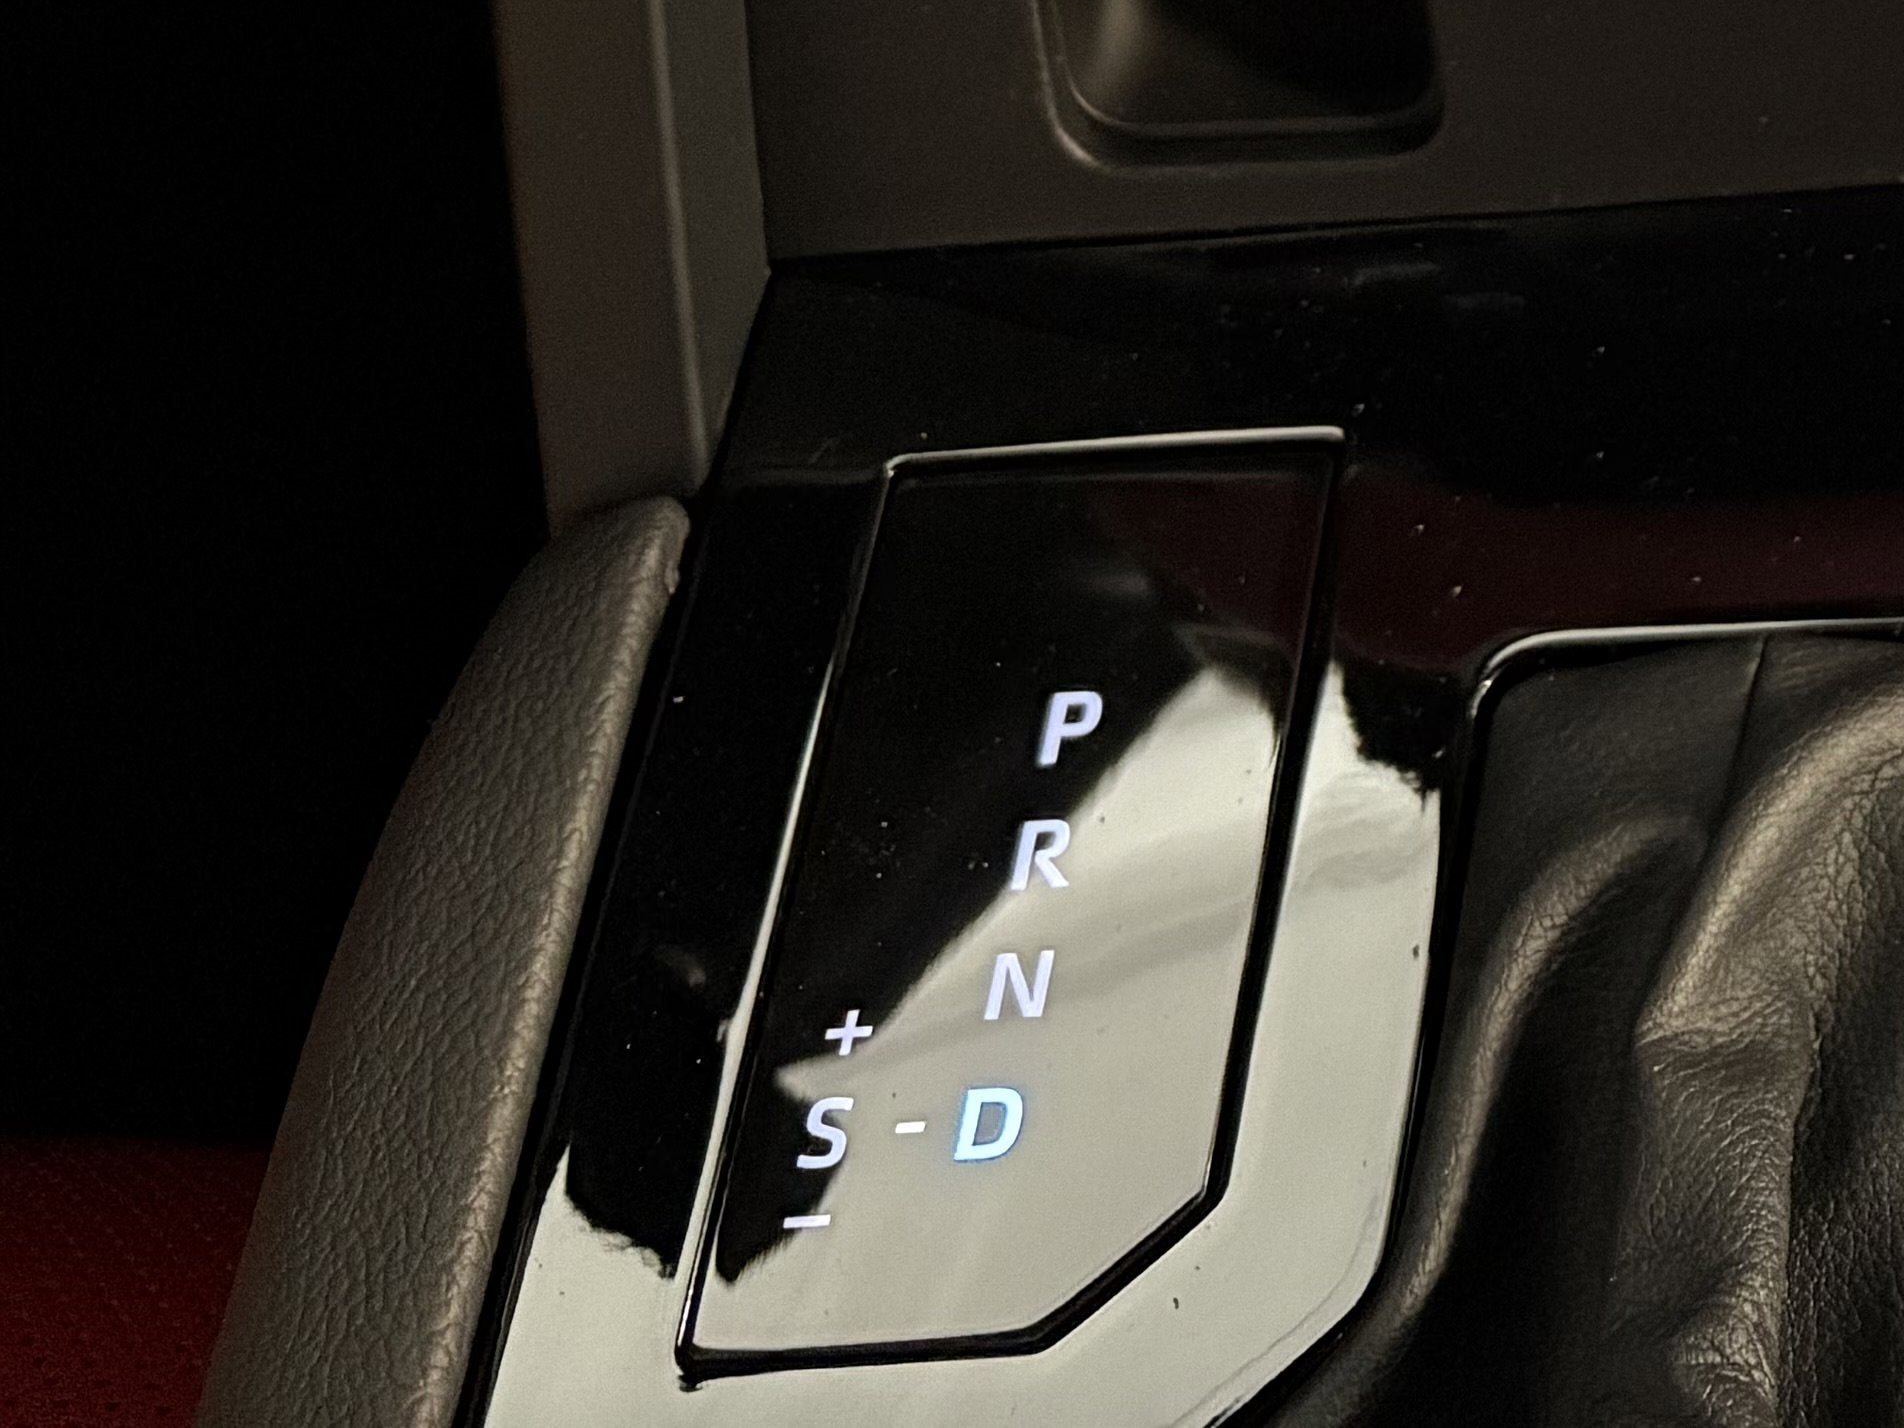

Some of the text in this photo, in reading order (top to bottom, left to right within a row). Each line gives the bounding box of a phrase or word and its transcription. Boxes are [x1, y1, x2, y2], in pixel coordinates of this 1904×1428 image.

[1036, 689, 1104, 769] P
[1009, 818, 1072, 892] R
[983, 948, 1056, 1021] N
[795, 1095, 855, 1170] S
[952, 1086, 1025, 1163] D
